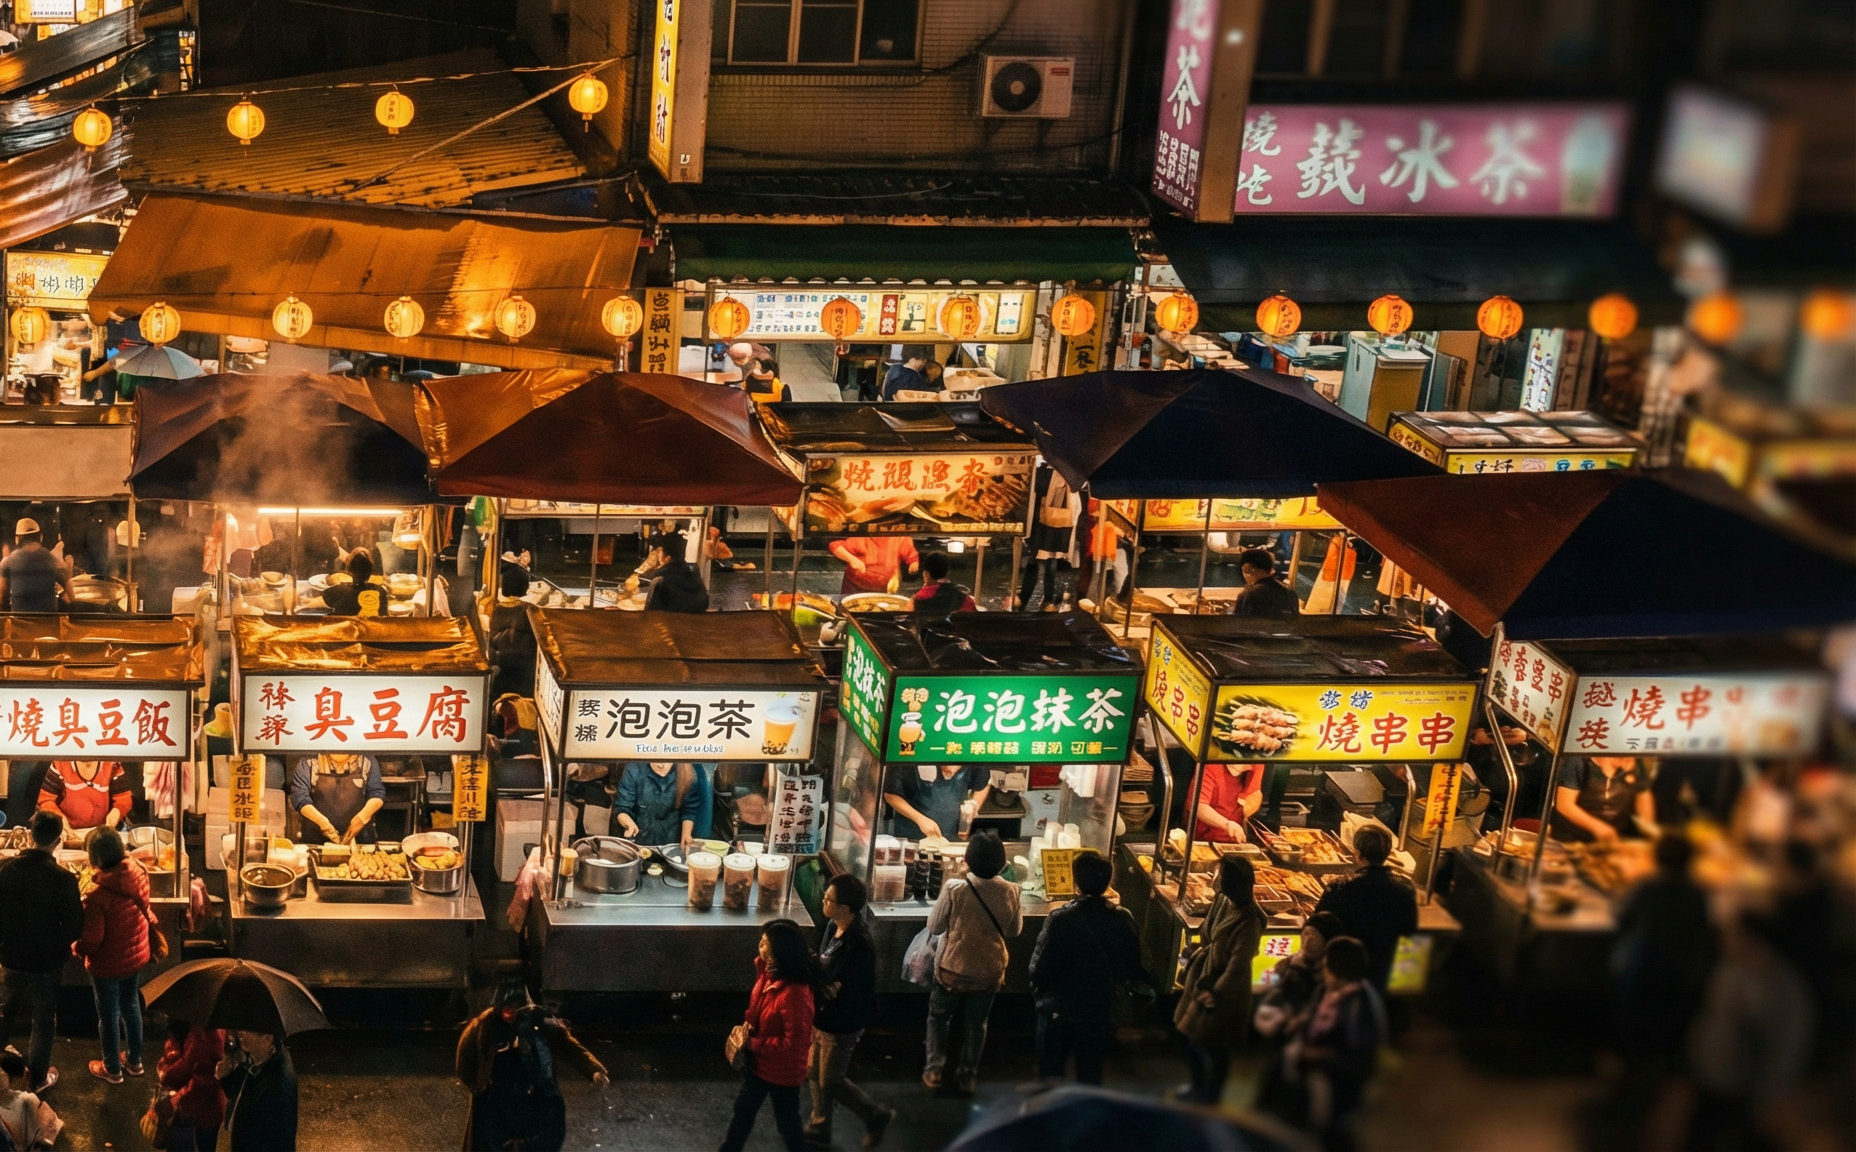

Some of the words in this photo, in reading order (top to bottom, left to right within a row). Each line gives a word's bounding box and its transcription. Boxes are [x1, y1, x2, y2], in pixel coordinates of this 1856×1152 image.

[7, 697, 178, 749] 燒臭豆飯
[605, 697, 756, 740] 泡泡茶
[1316, 711, 1456, 755] 燒串串
